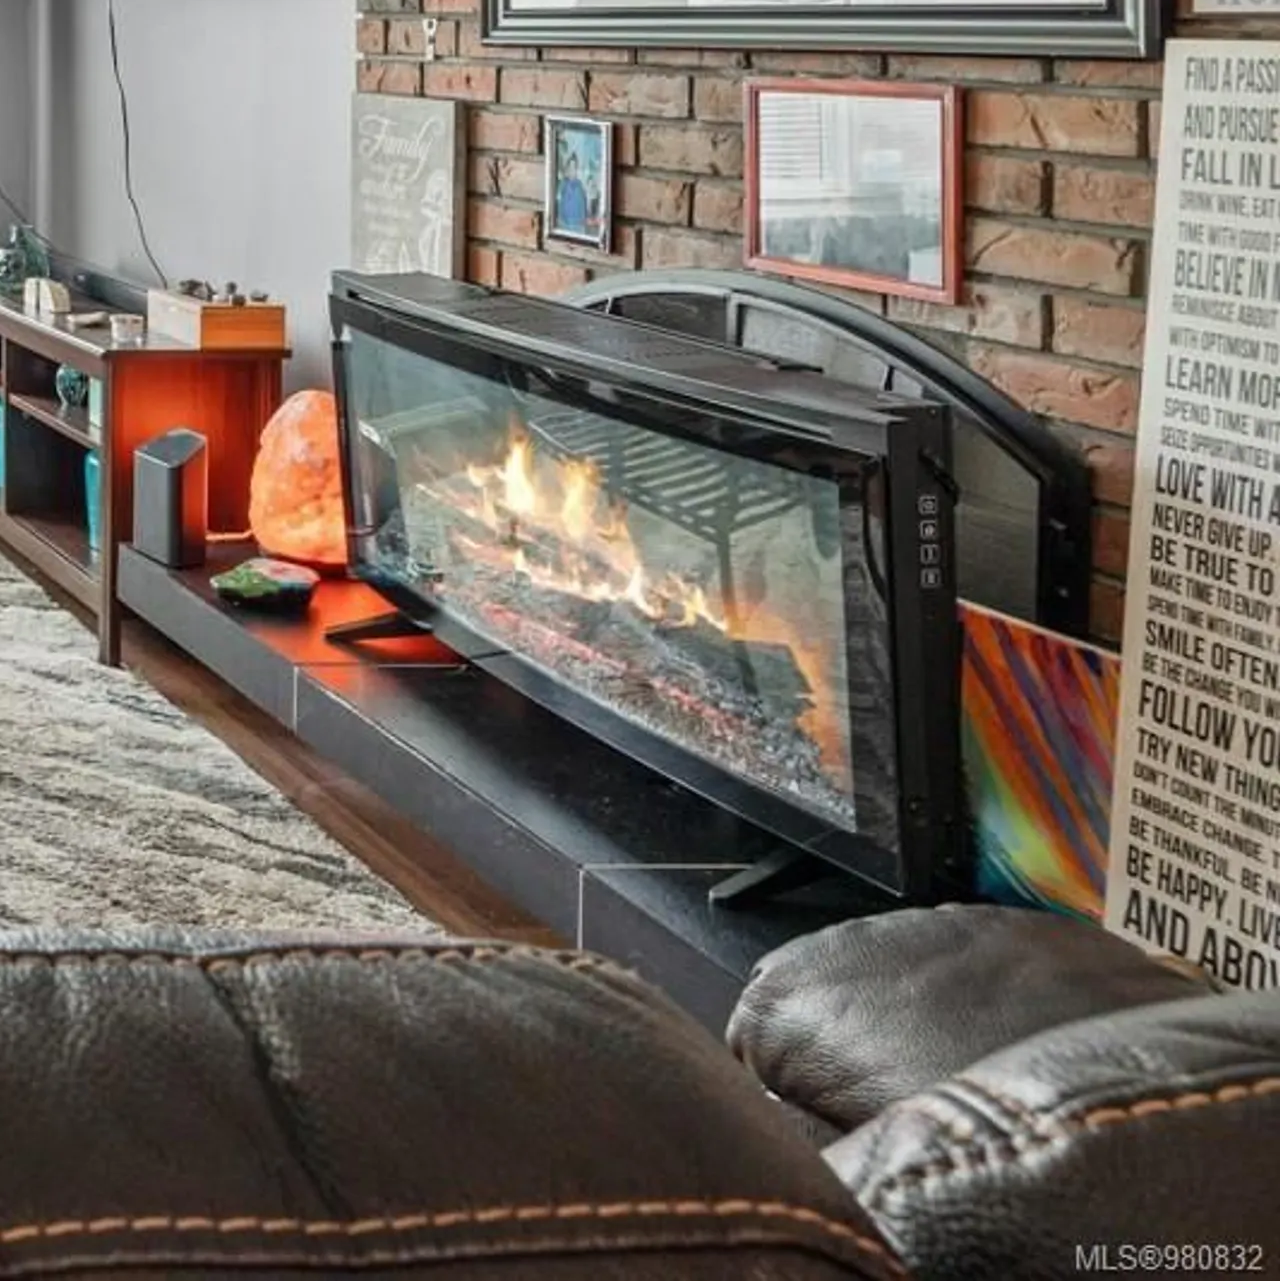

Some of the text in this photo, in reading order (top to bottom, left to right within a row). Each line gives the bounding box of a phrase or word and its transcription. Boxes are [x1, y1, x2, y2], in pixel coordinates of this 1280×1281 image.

[1185, 56, 1218, 93] FIND
[1221, 56, 1233, 93] A
[1184, 104, 1278, 145] AND PURSUE
[1181, 147, 1233, 185] FALL
[1239, 151, 1263, 189] IN
[1175, 250, 1244, 295] BELIEVE
[1248, 257, 1269, 300] IN
[1165, 354, 1233, 401] LEARN
[1163, 396, 1209, 426] SPEND
[1213, 406, 1249, 435] TIME
[1155, 452, 1206, 505] LOVE
[1211, 467, 1264, 522] WITH
[1152, 502, 1204, 541] NEVER
[1207, 518, 1245, 553] GIVE
[1150, 534, 1275, 597] BE TRUE TO
[1142, 651, 1158, 675] BE
[1145, 619, 1204, 665] SMILE
[1138, 678, 1236, 753] FOLLOW
[1137, 725, 1173, 765] TRY
[1175, 743, 1220, 785] NEW
[1131, 787, 1199, 834] EMBRACE
[1126, 844, 1152, 887] BE
[1128, 814, 1150, 843] BE
[1241, 865, 1262, 896] BE
[1123, 888, 1189, 957] AND
